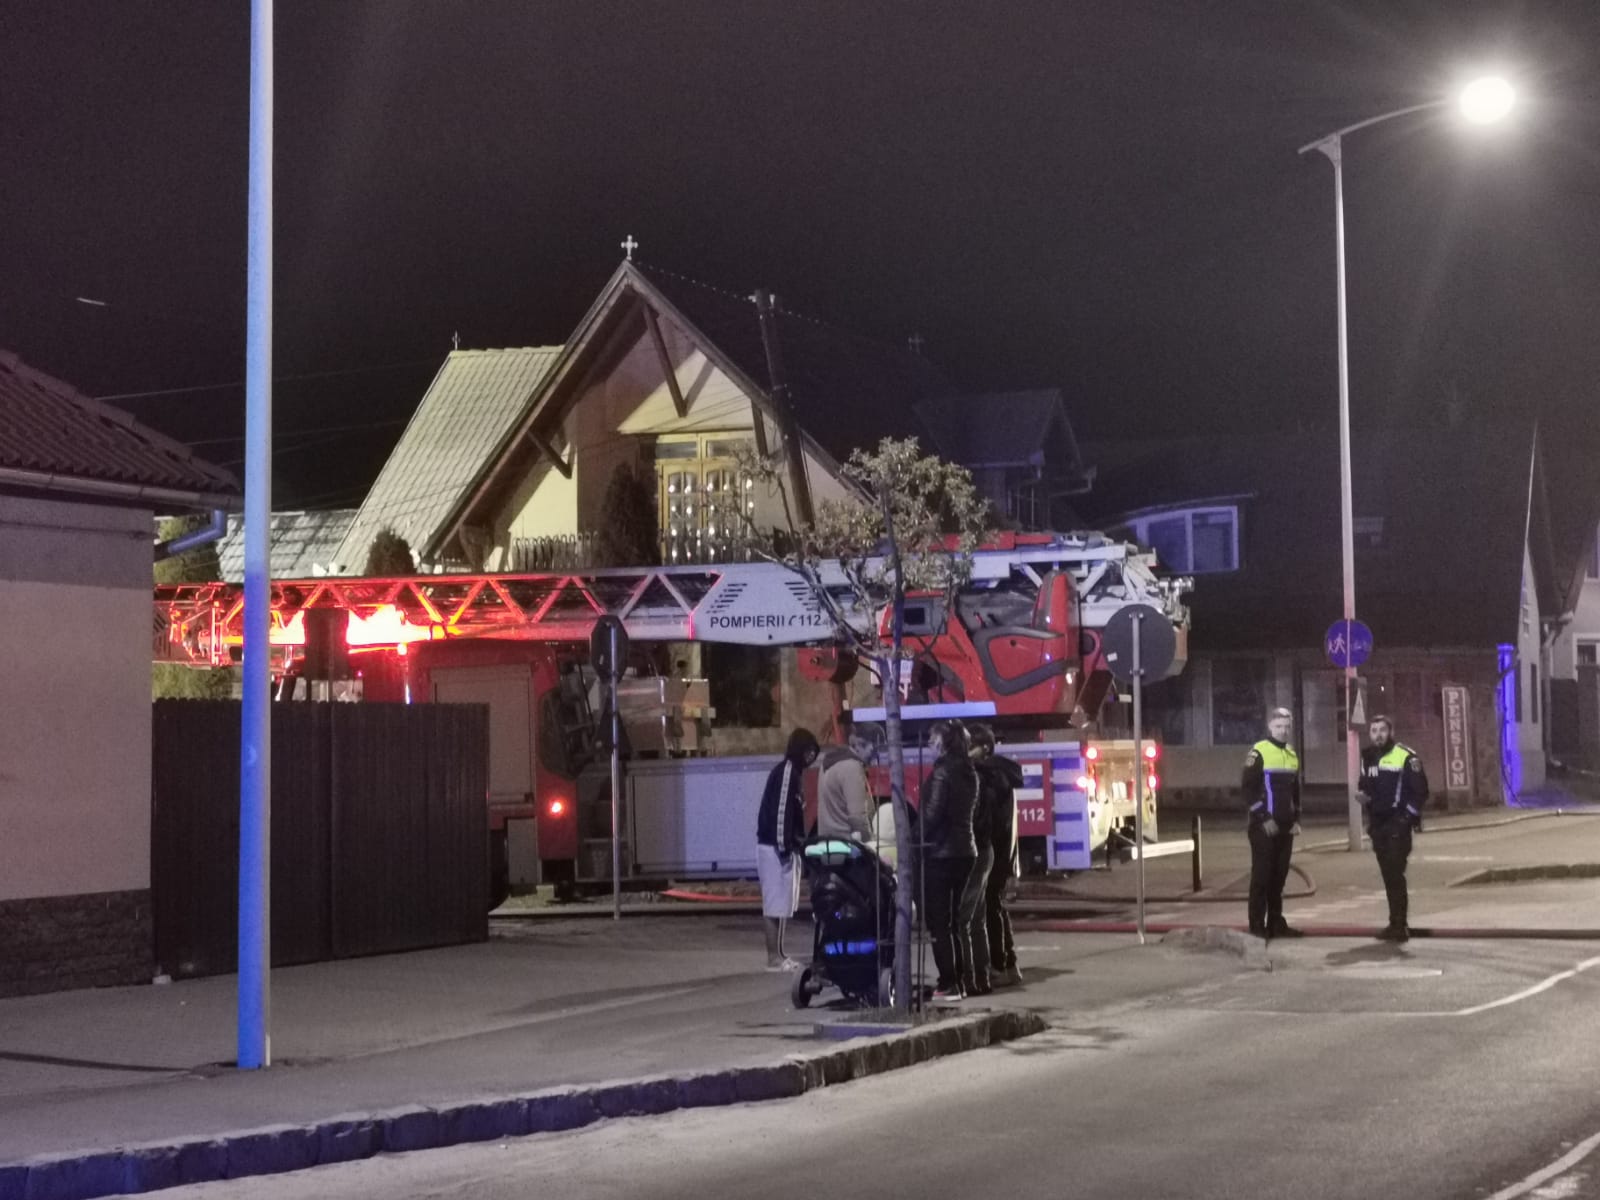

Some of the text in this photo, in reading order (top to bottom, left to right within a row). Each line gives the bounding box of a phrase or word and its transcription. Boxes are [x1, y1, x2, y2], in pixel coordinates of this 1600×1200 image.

[710, 614, 821, 628] POMPIERII 112
[1447, 691, 1465, 785] PENSION
[1021, 807, 1045, 822] 112
